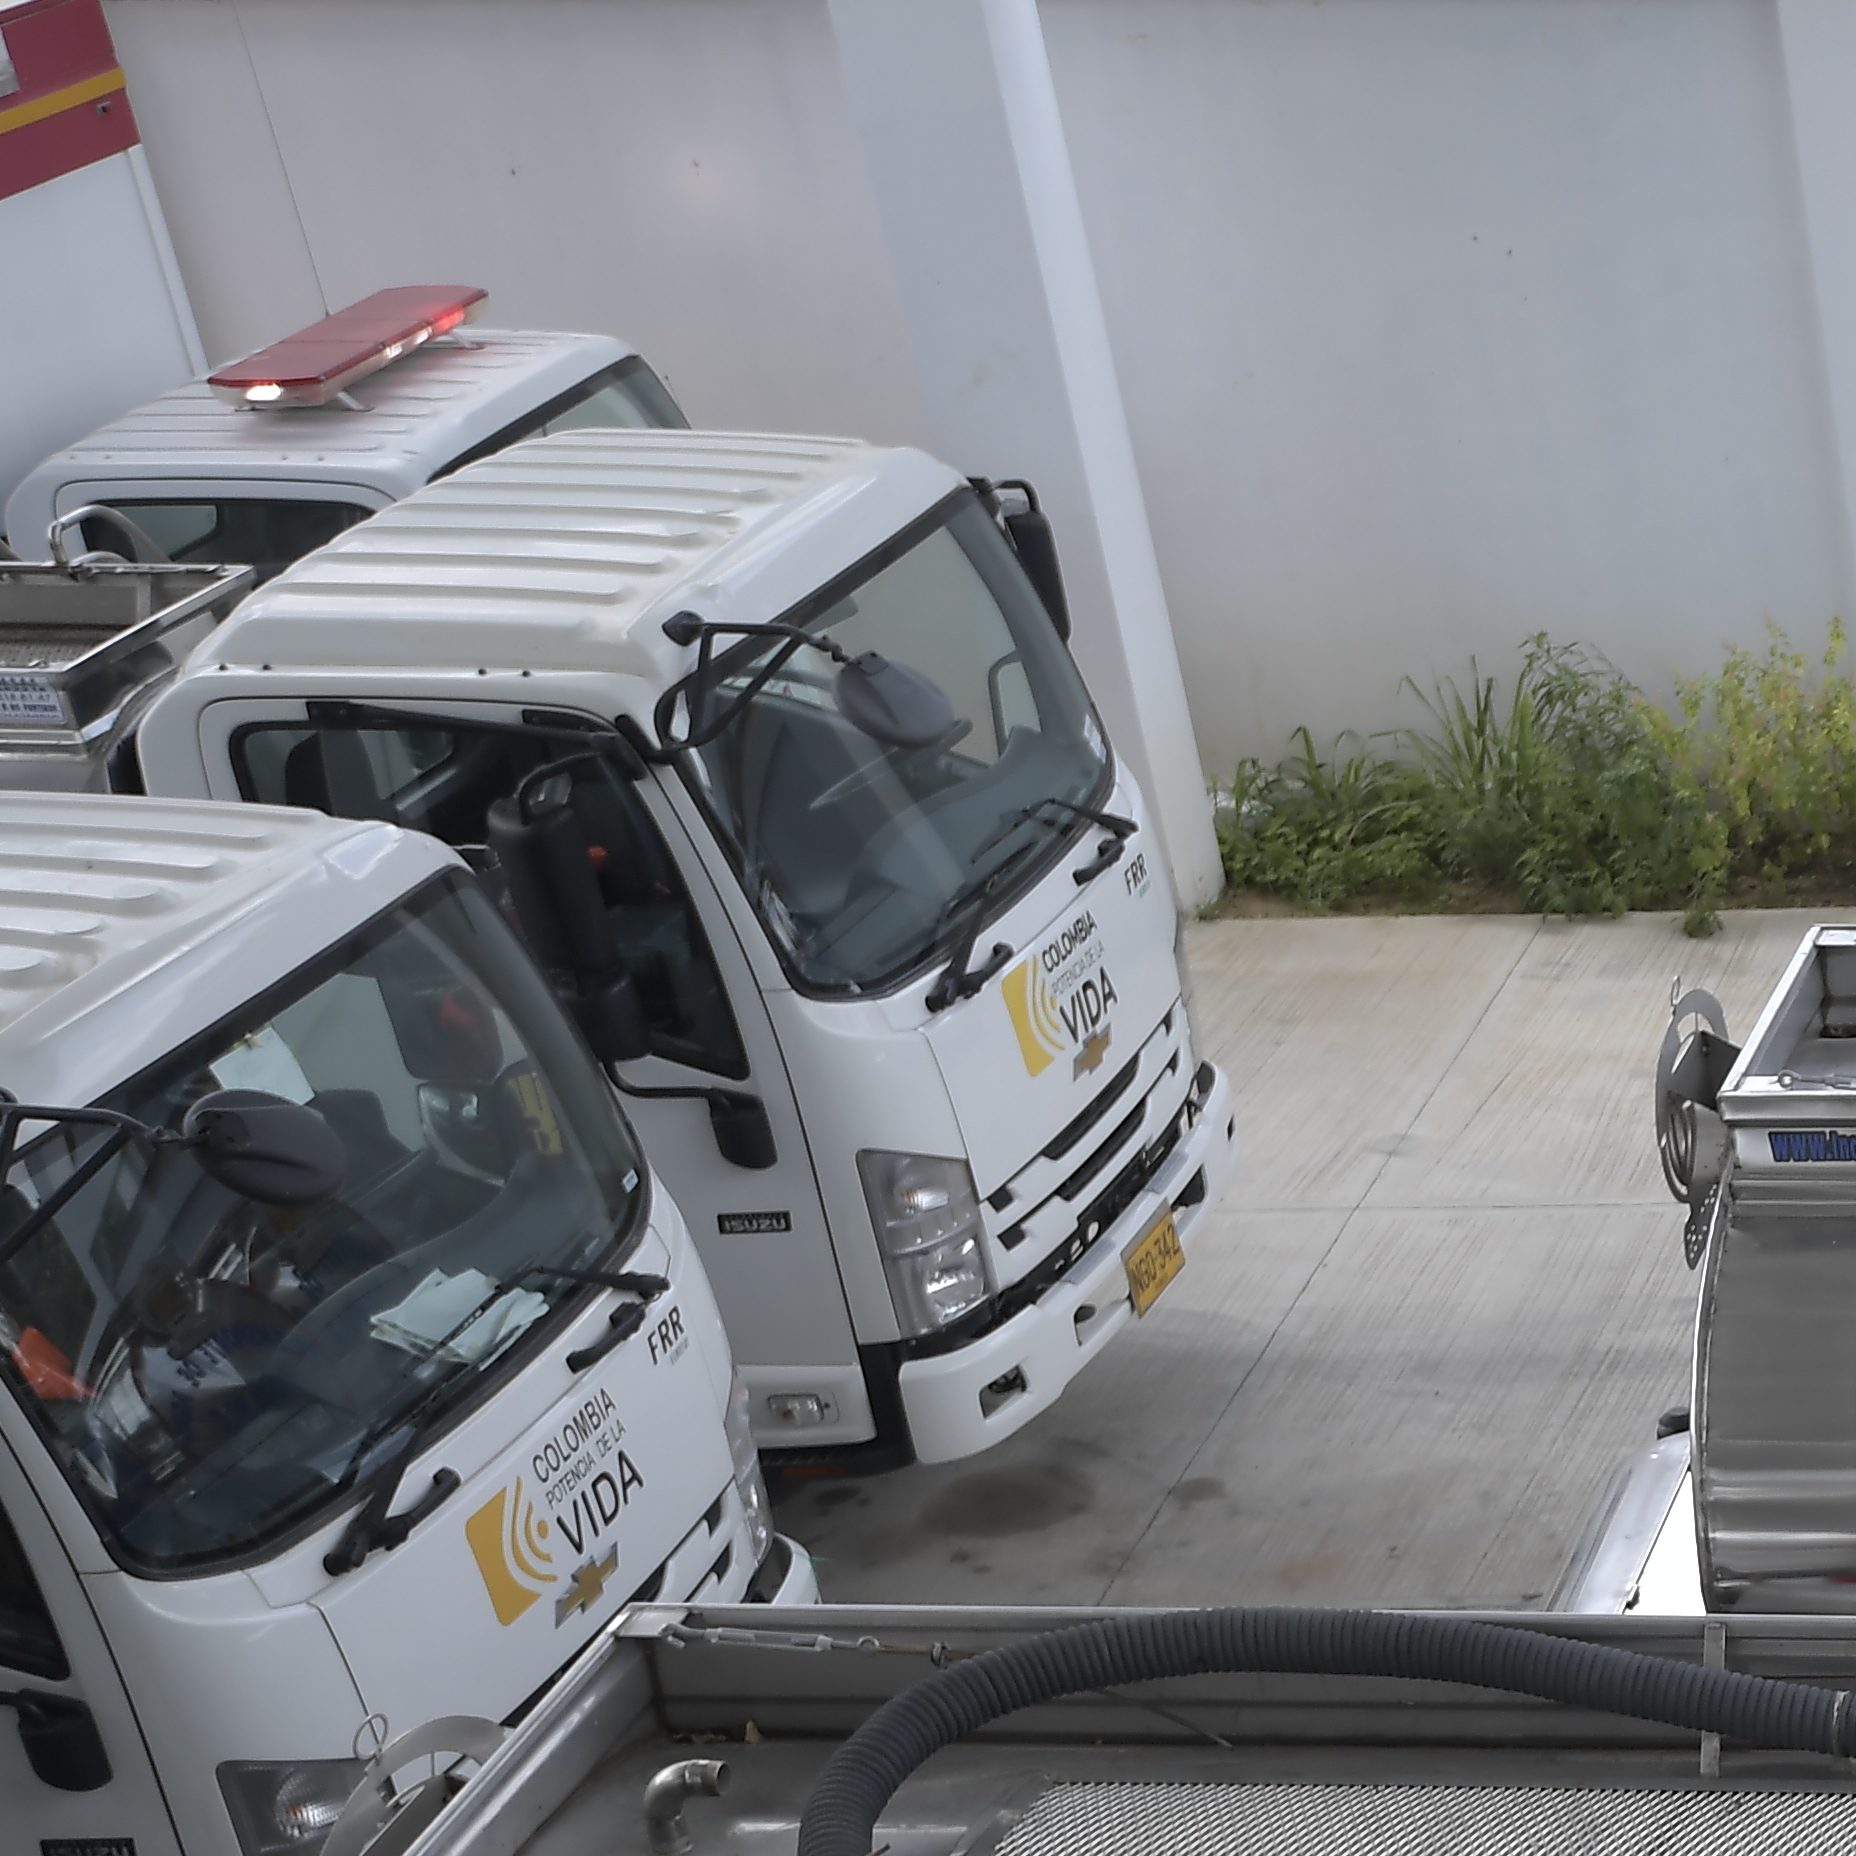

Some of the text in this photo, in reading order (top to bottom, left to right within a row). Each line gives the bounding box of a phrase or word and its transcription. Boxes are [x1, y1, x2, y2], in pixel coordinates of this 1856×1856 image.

[1123, 853, 1147, 895] FRR
[1042, 910, 1098, 972] COLOMBIA
[1060, 966, 1118, 1044] VIDA
[724, 1218, 787, 1231] ISUZU
[647, 1304, 685, 1366] FRR
[532, 1387, 617, 1484] COLOMBIA
[546, 1418, 627, 1510] POTENCIA DE LA
[556, 1449, 644, 1556] VIDA
